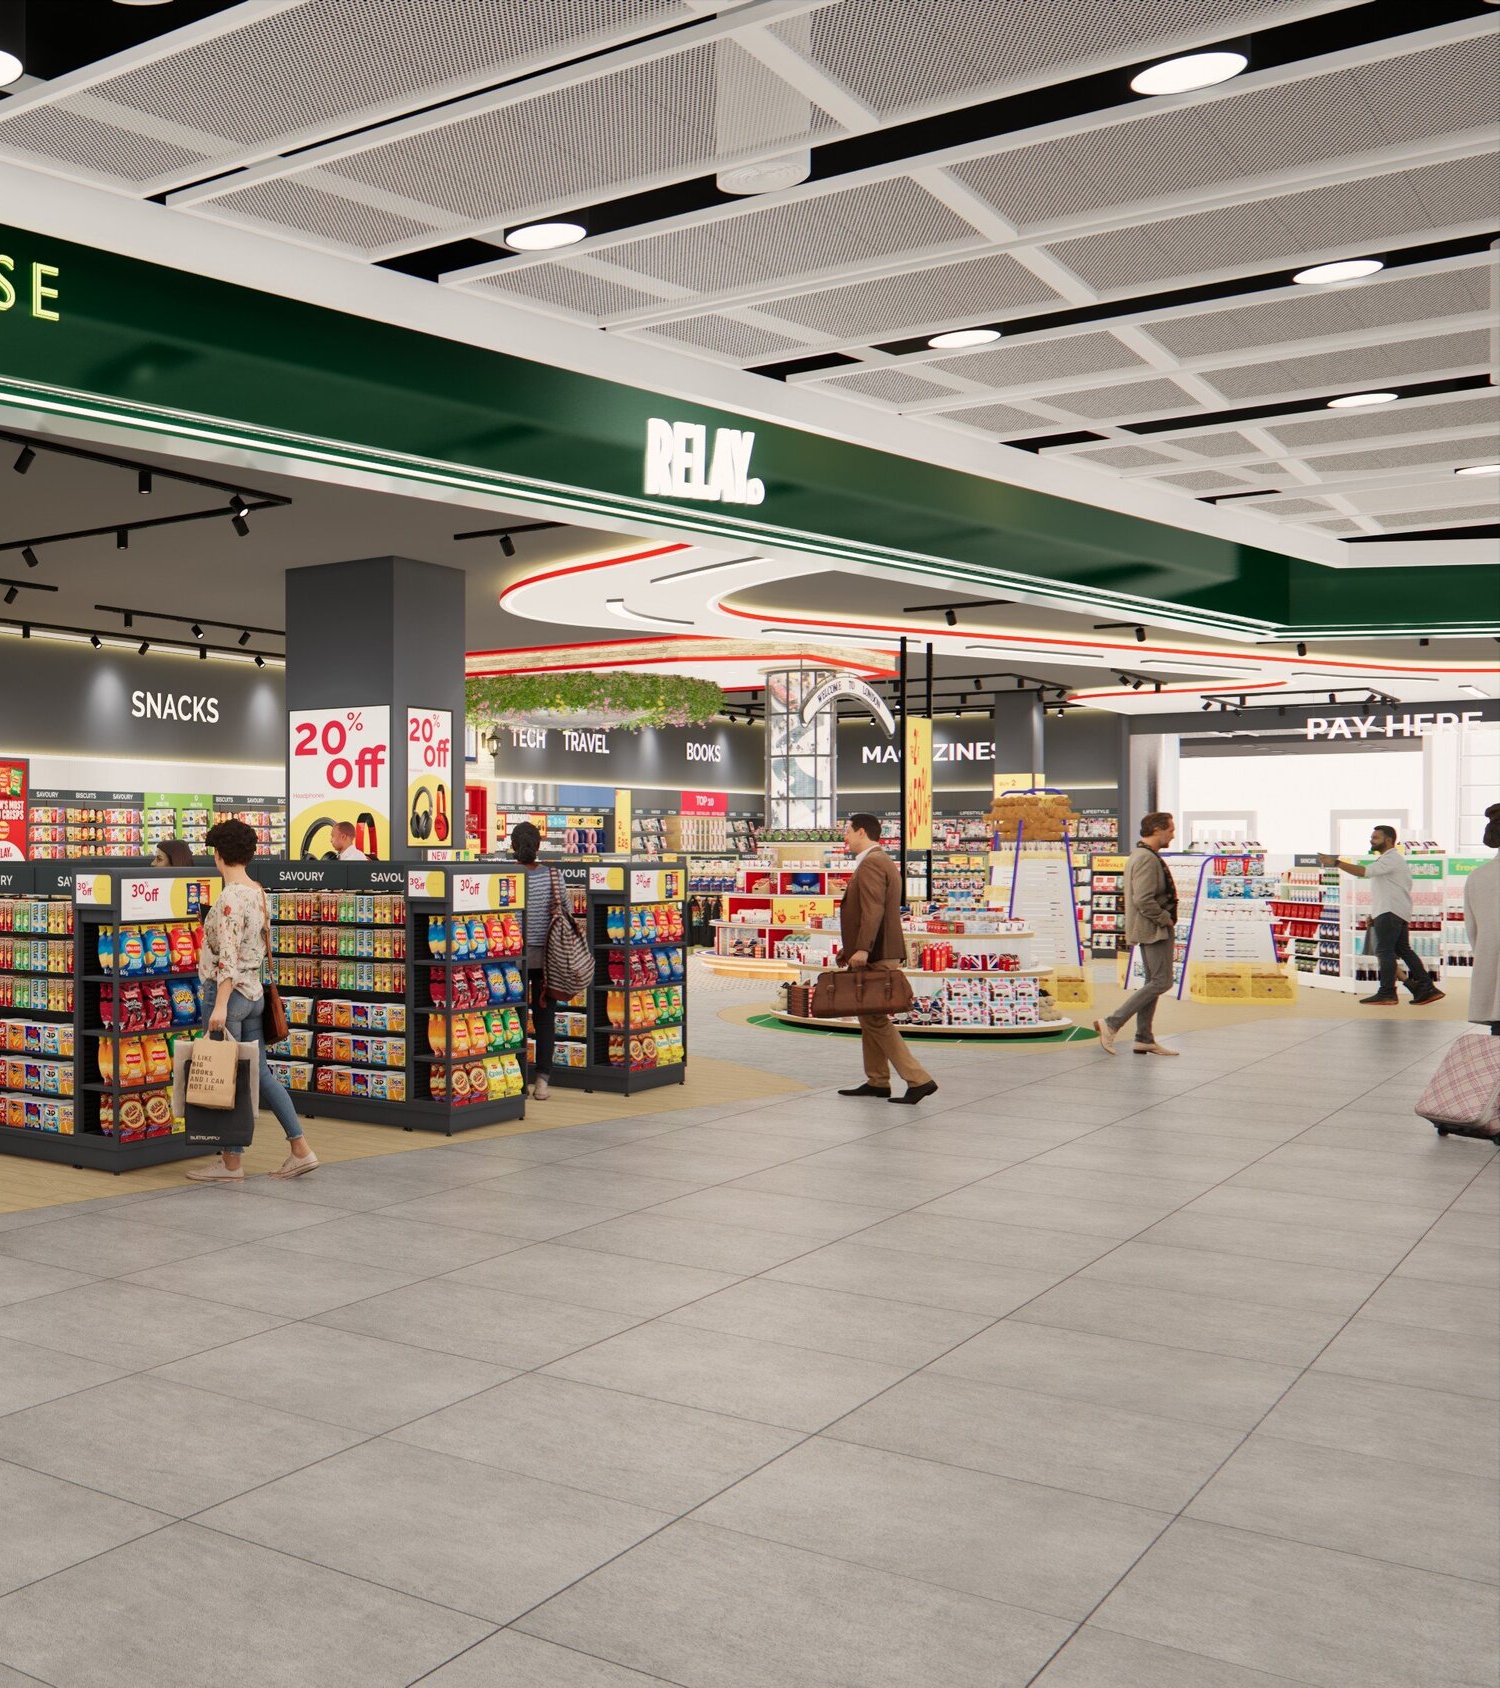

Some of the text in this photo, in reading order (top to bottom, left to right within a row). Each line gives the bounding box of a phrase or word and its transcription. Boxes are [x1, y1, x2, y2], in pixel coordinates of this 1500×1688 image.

[817, 680, 881, 708] WELCOME TO LONDON
[131, 690, 219, 723] SNACKS
[409, 714, 441, 742] 20%
[1306, 715, 1376, 740] PAY
[511, 728, 546, 749] TECH
[563, 731, 610, 754] TRAVEL
[295, 712, 387, 789] 20% off
[424, 738, 450, 767] off
[686, 742, 721, 763] BOOKS
[862, 741, 996, 764] MAZINE
[9, 800, 24, 810] MOST
[696, 795, 707, 806] TOP
[2, 810, 24, 820] CRISPS
[431, 851, 448, 860] NEW
[279, 871, 324, 881] SAVOURY
[82, 885, 92, 896] off
[415, 881, 425, 890] off
[469, 883, 480, 895] off
[144, 888, 159, 902] off
[809, 902, 816, 910] 2
[800, 910, 805, 921] 1
